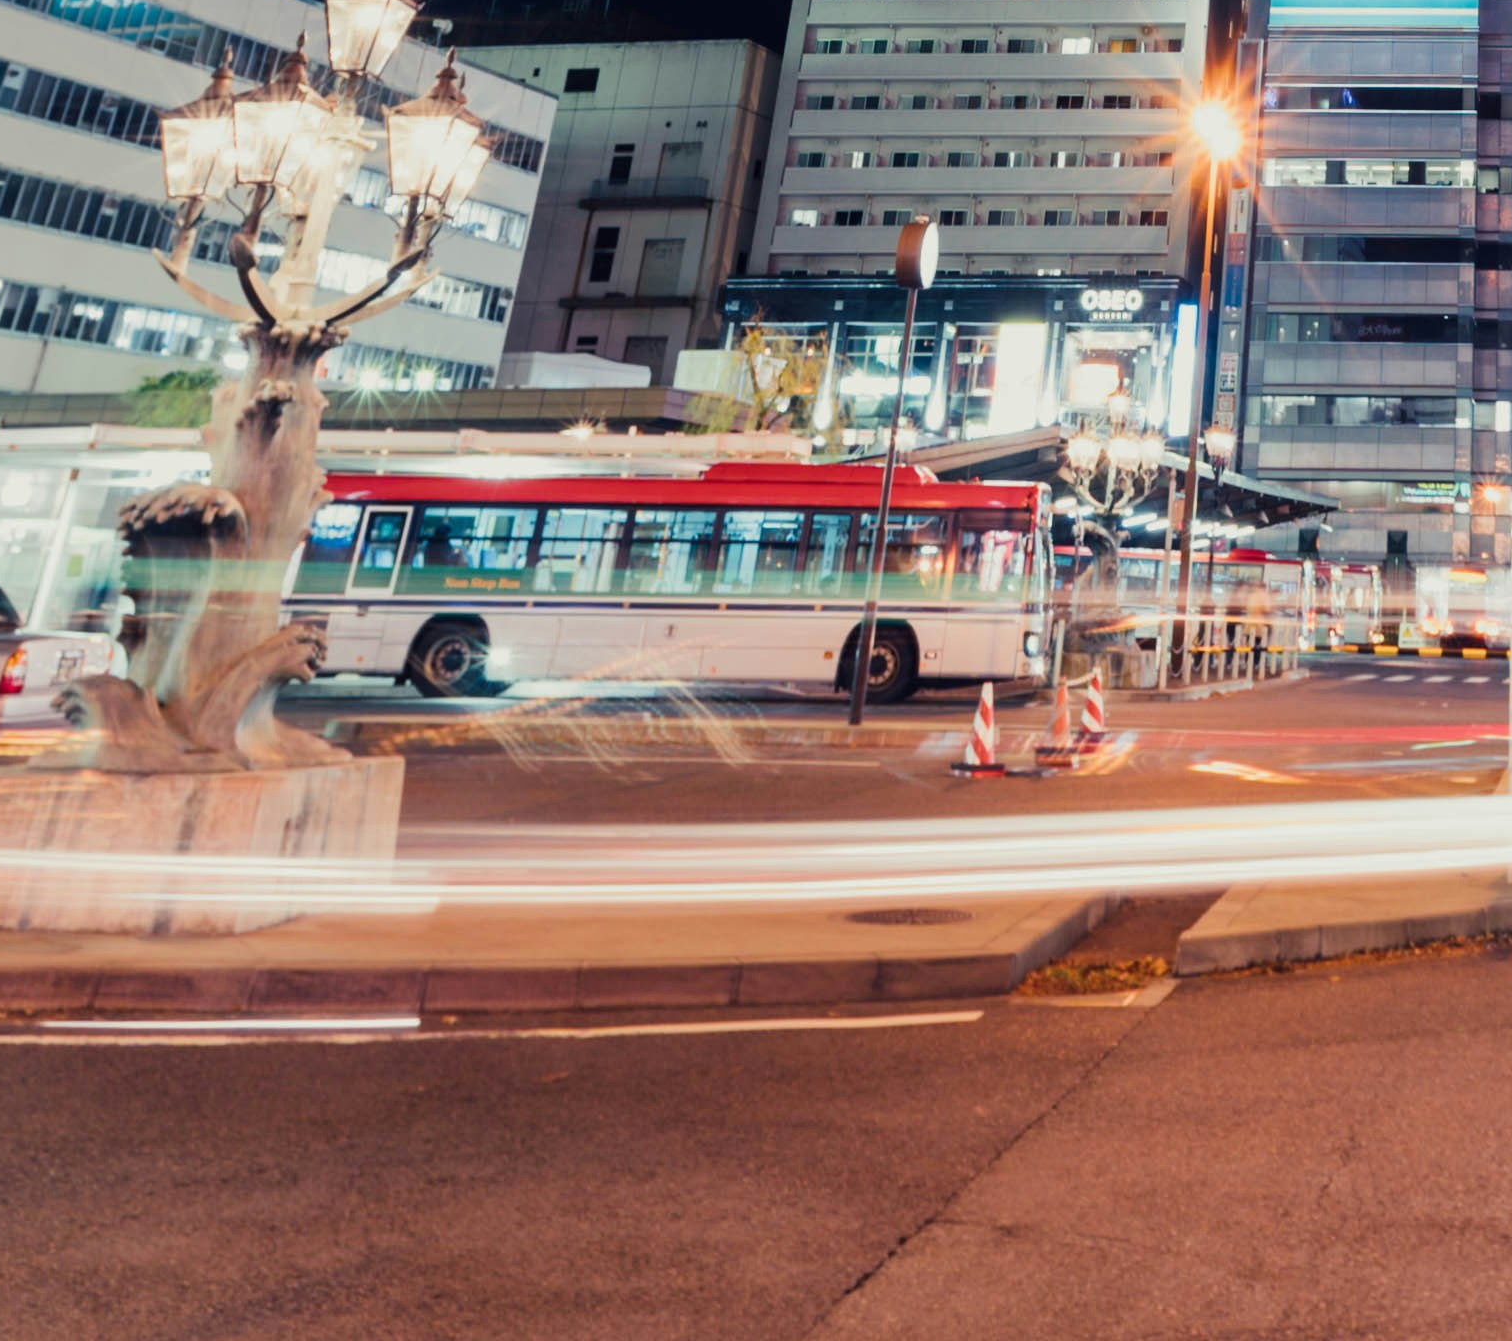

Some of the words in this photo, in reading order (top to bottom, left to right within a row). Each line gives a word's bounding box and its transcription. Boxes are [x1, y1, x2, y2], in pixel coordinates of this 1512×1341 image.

[1081, 289, 1143, 311] OSEO
[471, 577, 497, 592] Step
[498, 577, 521, 589] Bus
